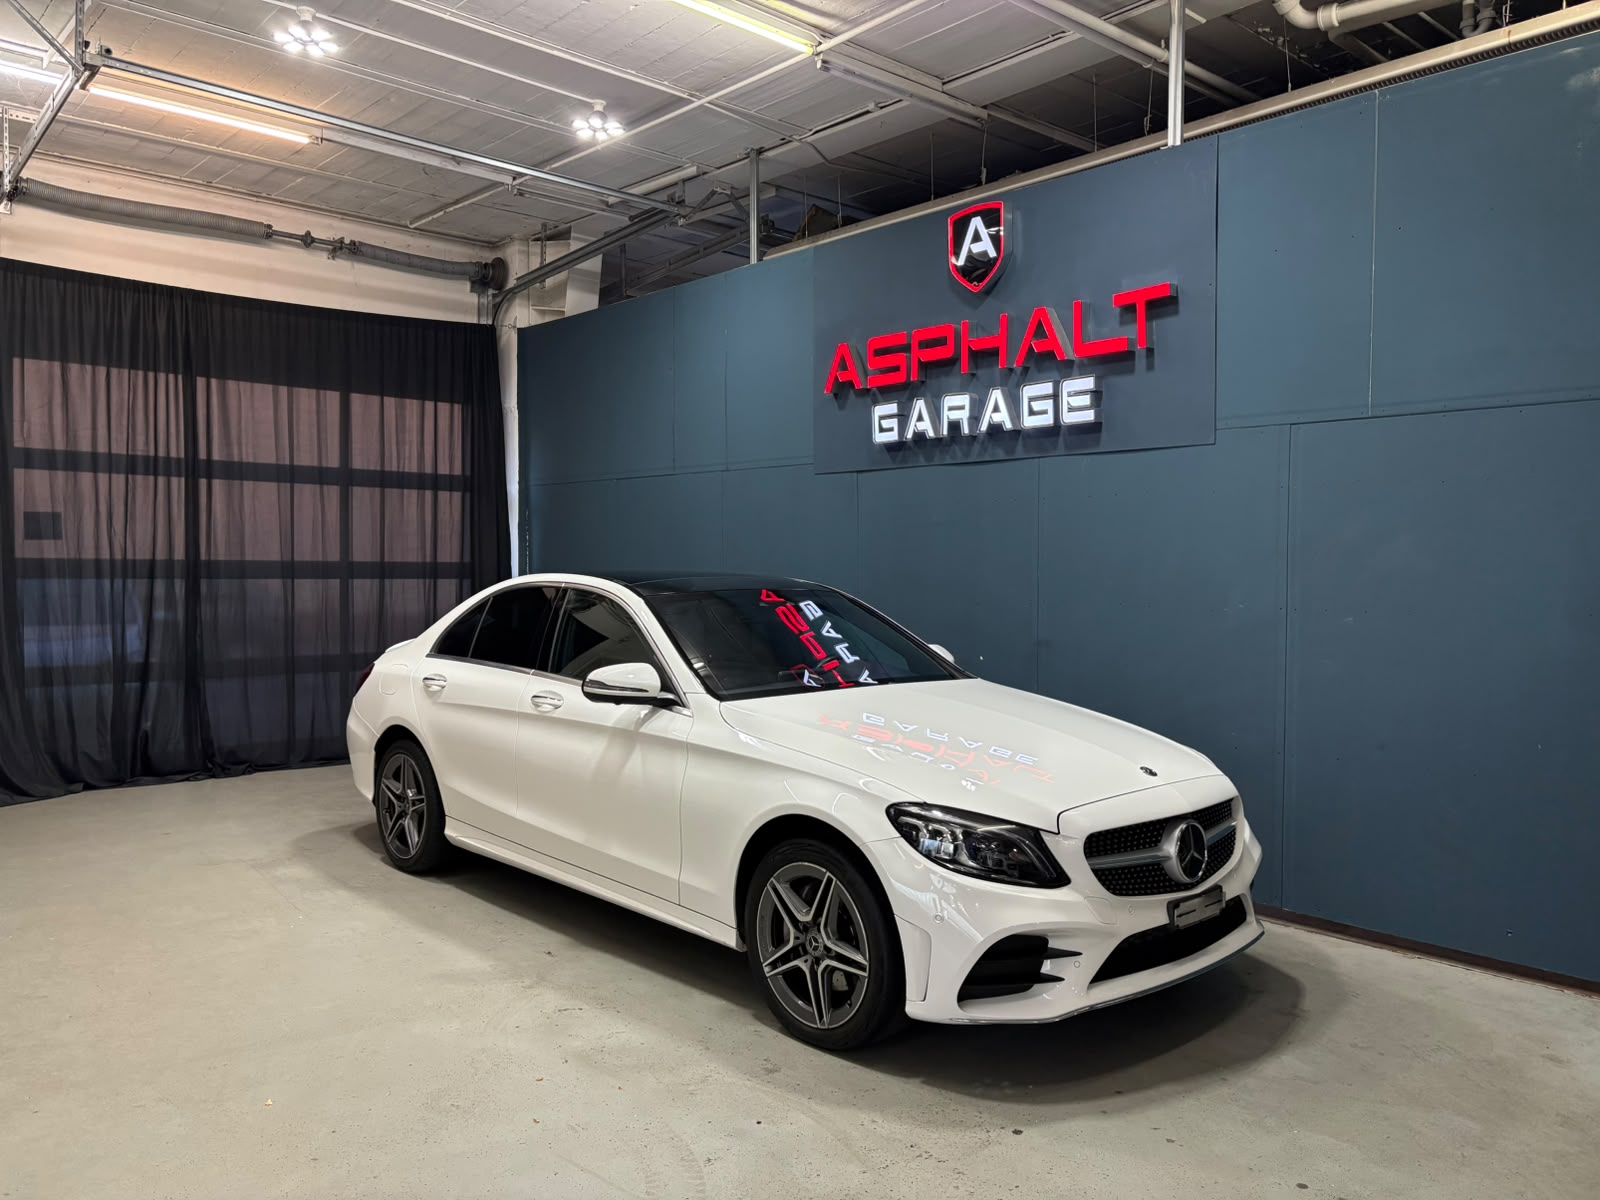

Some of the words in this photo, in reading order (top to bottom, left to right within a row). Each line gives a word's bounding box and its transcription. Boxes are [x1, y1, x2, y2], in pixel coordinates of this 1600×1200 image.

[954, 216, 998, 266] A
[824, 282, 1171, 394] ASPHALT
[872, 375, 1096, 445] GARAGE
